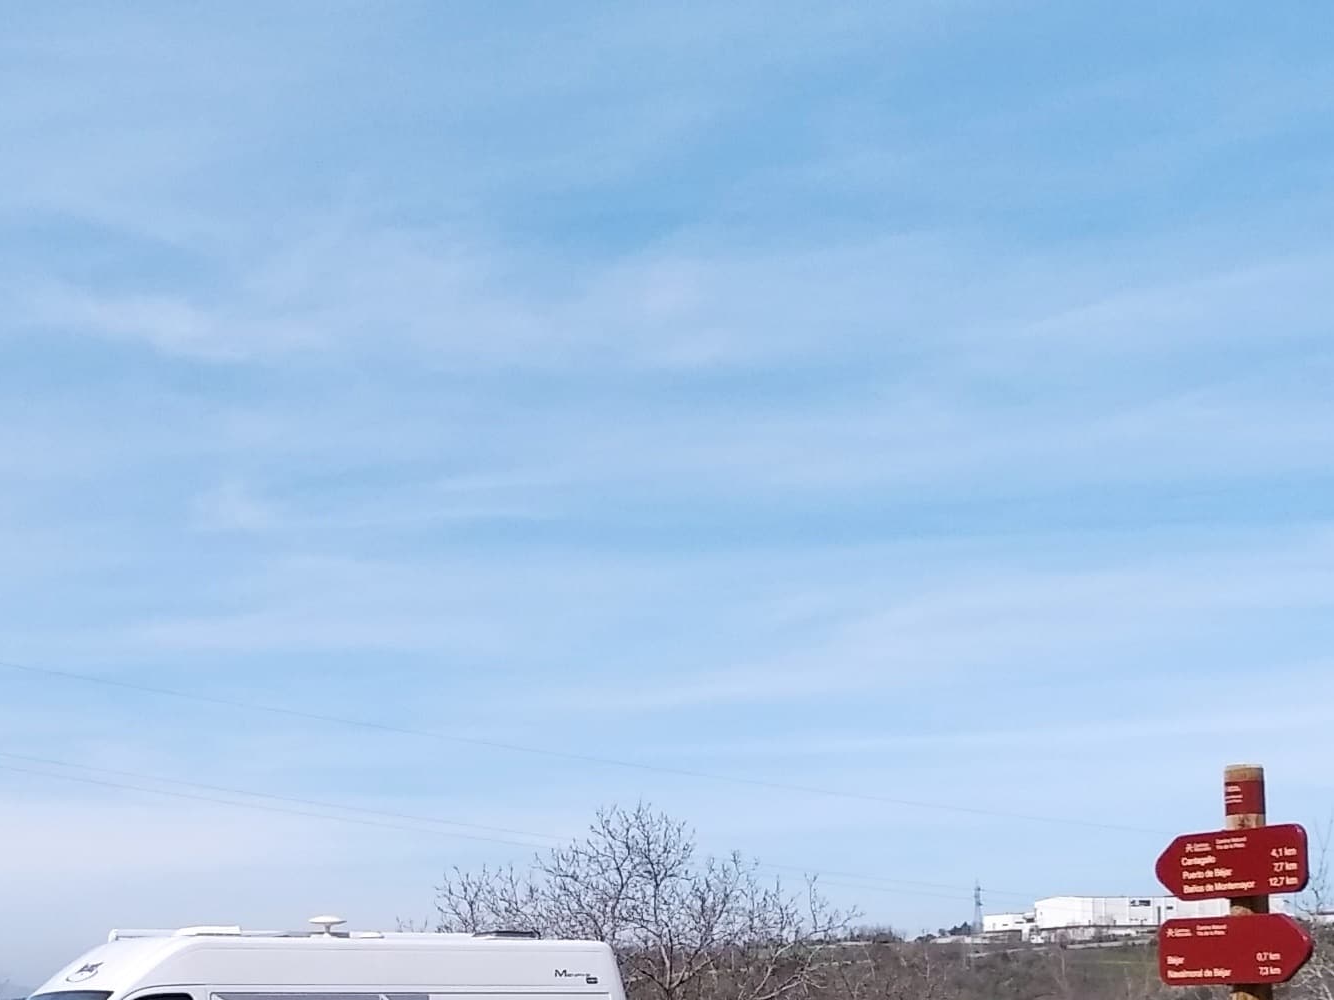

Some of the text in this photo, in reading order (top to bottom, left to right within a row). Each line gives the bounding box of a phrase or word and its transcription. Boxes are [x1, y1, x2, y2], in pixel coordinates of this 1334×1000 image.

[1284, 847, 1297, 856] km
[1204, 869, 1213, 878] de
[1285, 861, 1298, 870] km
[1205, 883, 1214, 892] de
[1285, 876, 1299, 885] km
[1269, 952, 1281, 960] km
[1269, 966, 1282, 975] km
